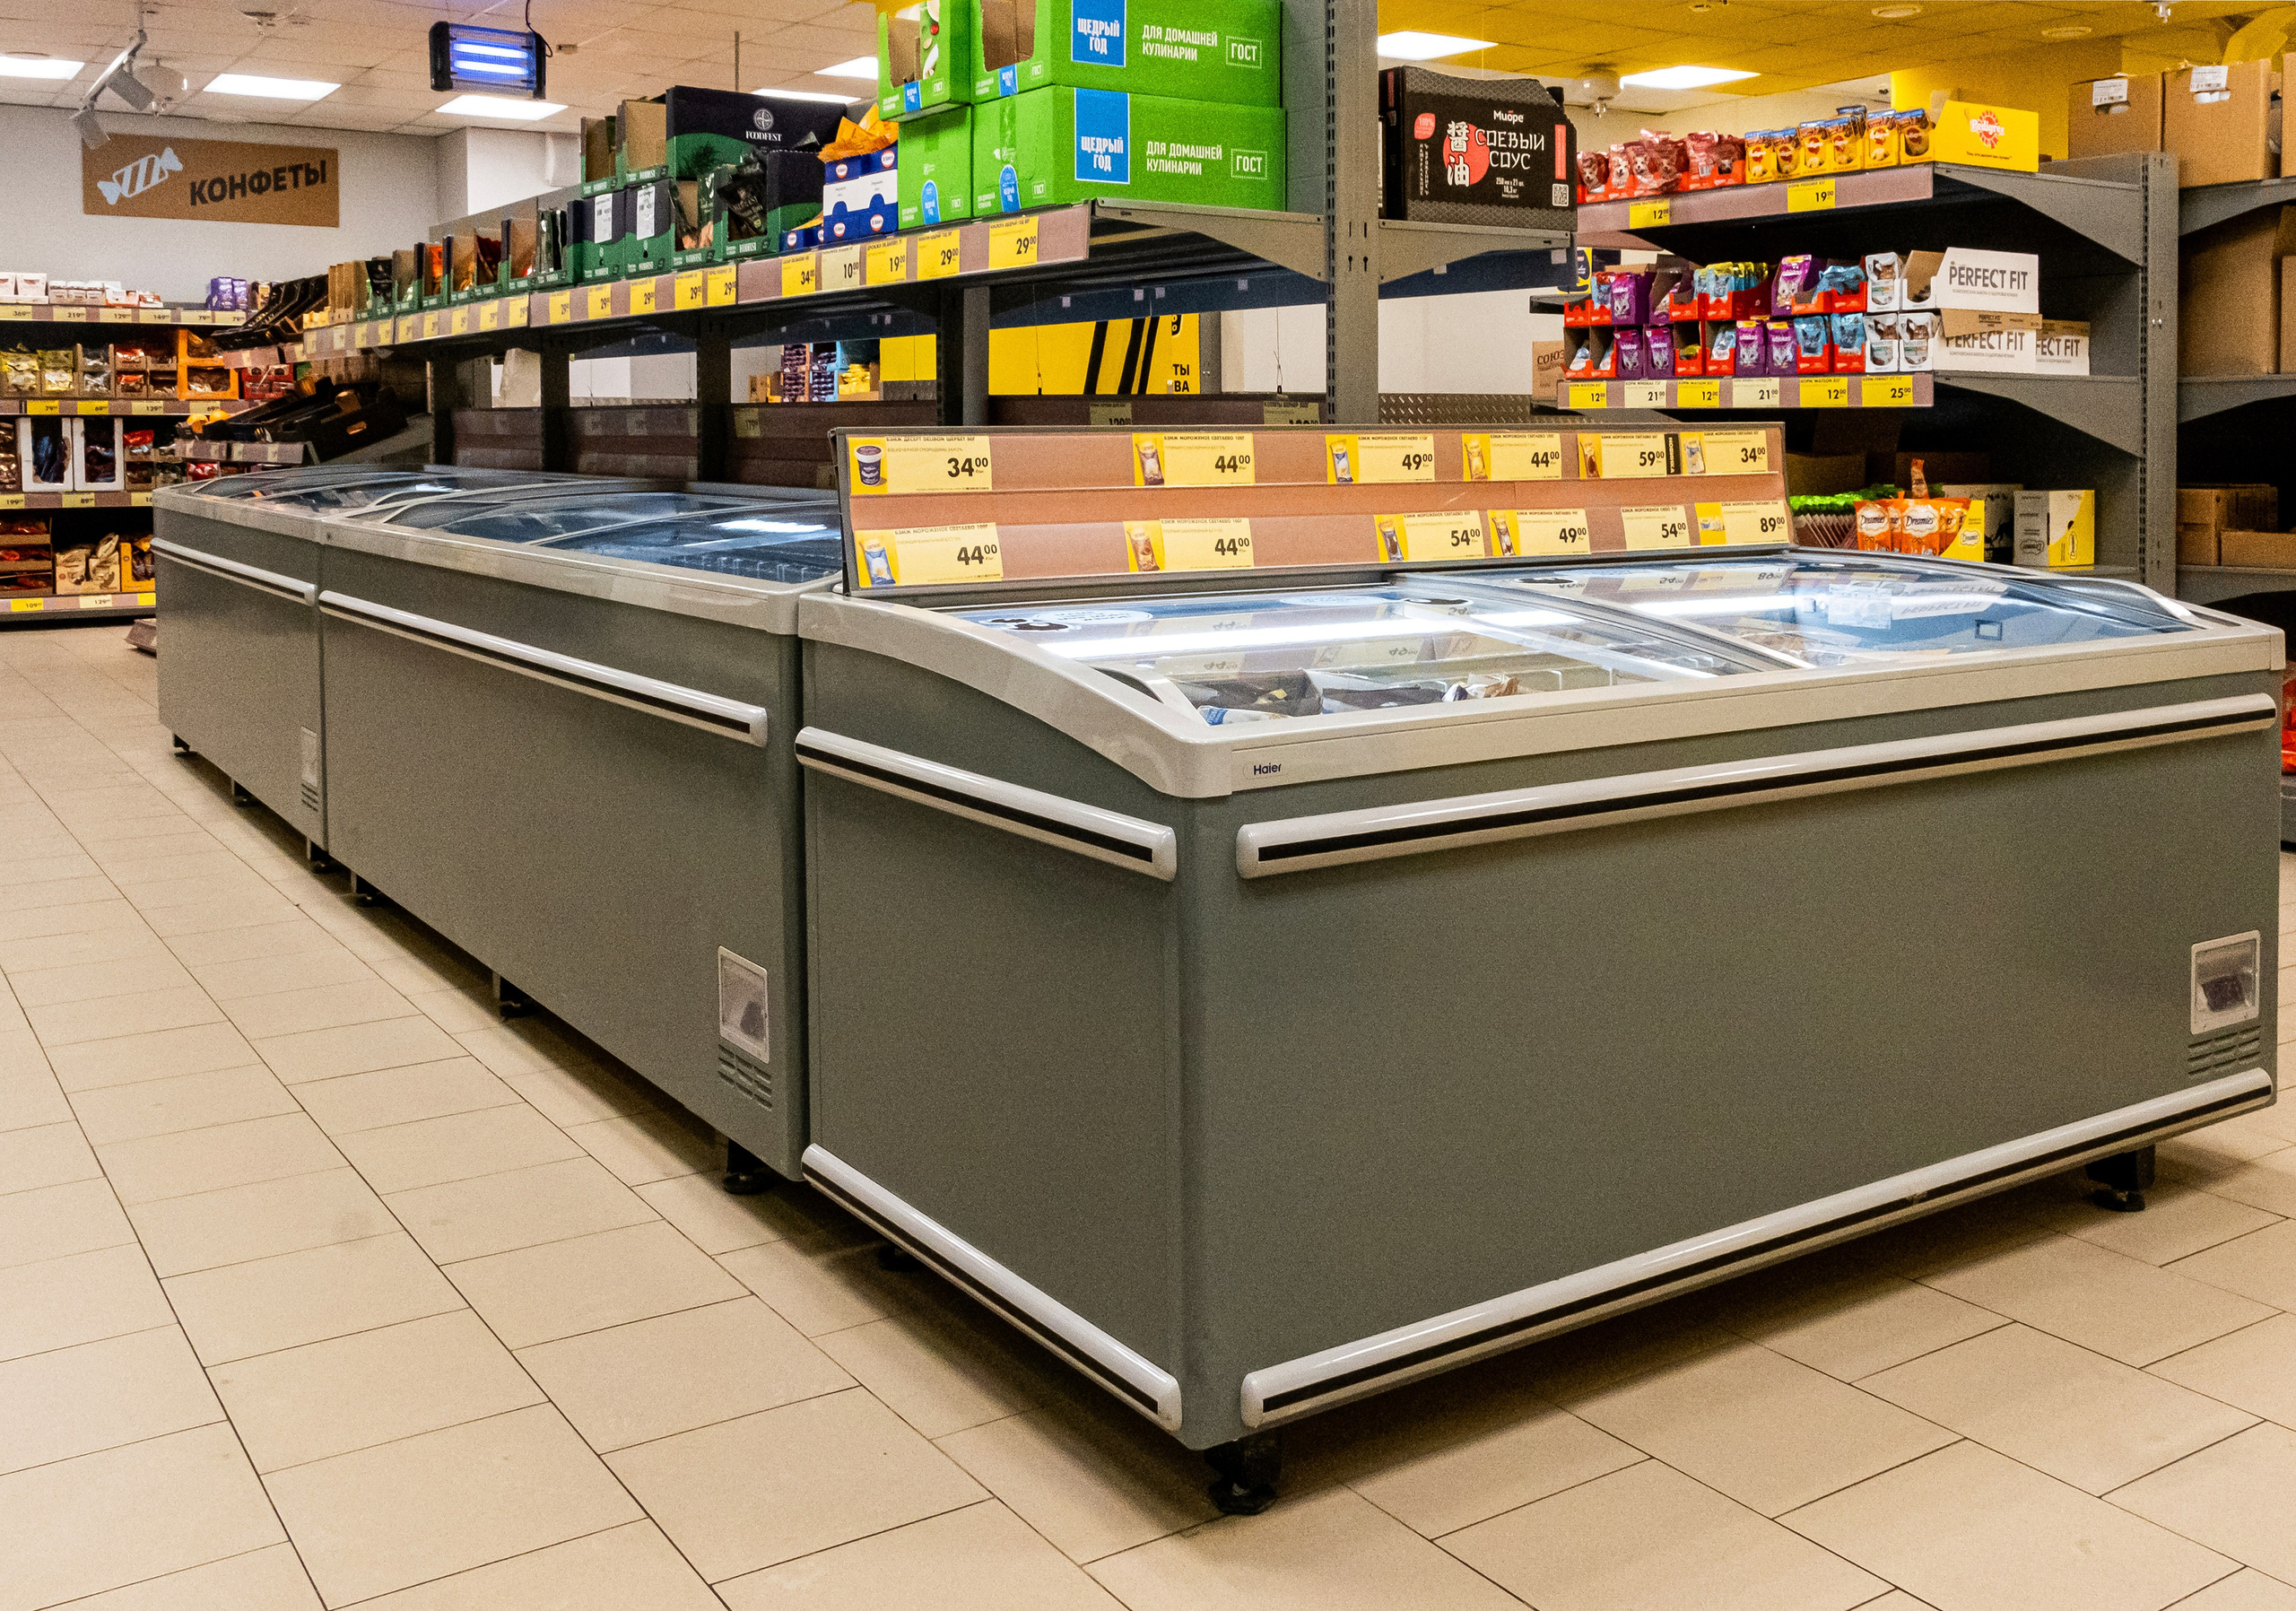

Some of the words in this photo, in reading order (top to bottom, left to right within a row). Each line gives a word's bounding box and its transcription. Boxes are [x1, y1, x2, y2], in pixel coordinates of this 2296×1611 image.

[1077, 18, 1120, 38] ЩЕДРЫЙ
[1142, 24, 1162, 40] ДЛЯ
[1164, 27, 1218, 47] ДОМАШНЕЙ
[1089, 37, 1108, 56] ГОД
[1142, 41, 1198, 62] КУЛИНАРИИ
[1231, 42, 1257, 62] ГОСТ
[1081, 136, 1124, 154] ЩЕДРЫЙ
[1475, 128, 1544, 152] СОЕВЫЙ
[1146, 141, 1167, 156] ДЛЯ
[1169, 143, 1222, 161] ДОМАШНЕЙ
[1489, 150, 1531, 170] СОУС
[1092, 153, 1112, 172] ГОД
[1146, 158, 1202, 176] КУЛИНАРИИ
[1235, 154, 1263, 173] ГОСТ
[189, 160, 326, 206] КОНФЕТЫ
[1949, 266, 2006, 289] PERFECT
[2009, 270, 2029, 290] FIT
[2006, 331, 2025, 351] FIT
[2064, 338, 2081, 357] FIT
[1906, 515, 1935, 527] Dreamies
[1253, 762, 1282, 775] Haier
